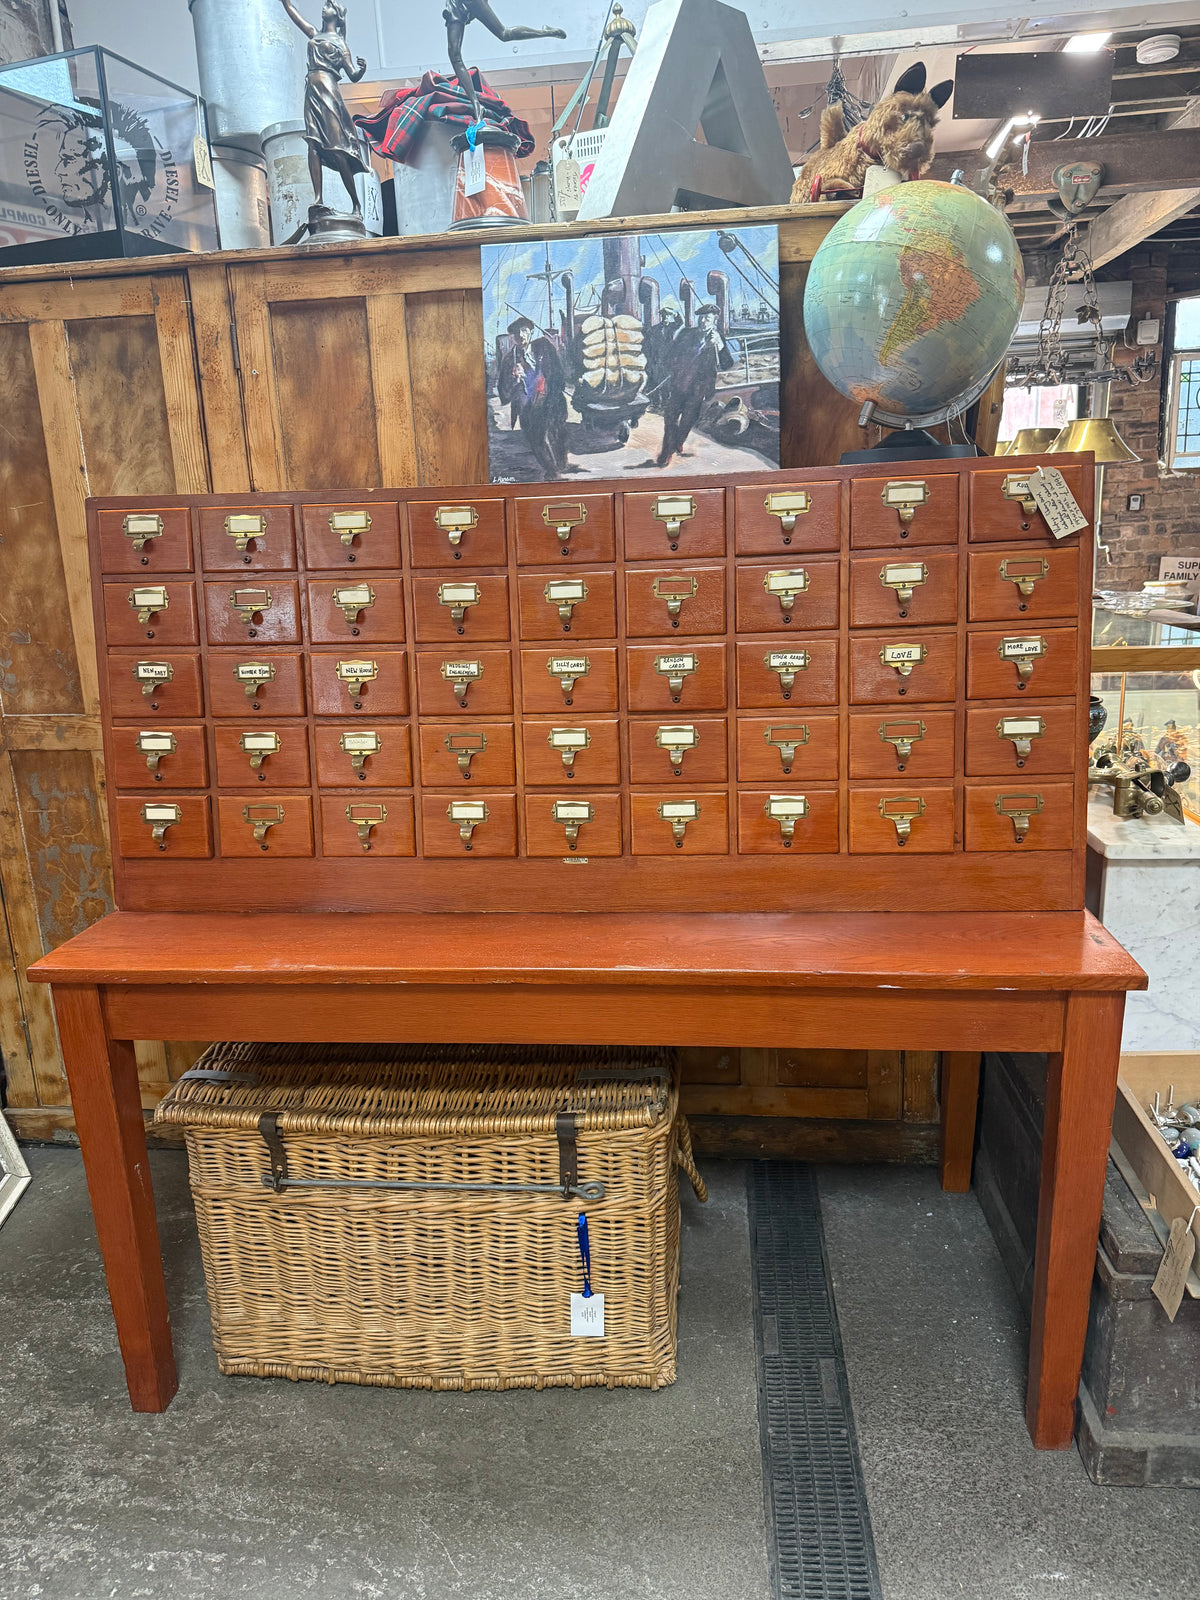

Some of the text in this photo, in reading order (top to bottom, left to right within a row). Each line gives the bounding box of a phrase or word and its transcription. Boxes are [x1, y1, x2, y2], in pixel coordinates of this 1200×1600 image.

[24, 142, 47, 197] DIESEL
[160, 151, 180, 203] DIESEL
[46, 204, 173, 238] ONLY RAVE
[1050, 472, 1070, 497] £1995
[1164, 572, 1199, 580] FAMILY
[891, 650, 913, 659] LOVE
